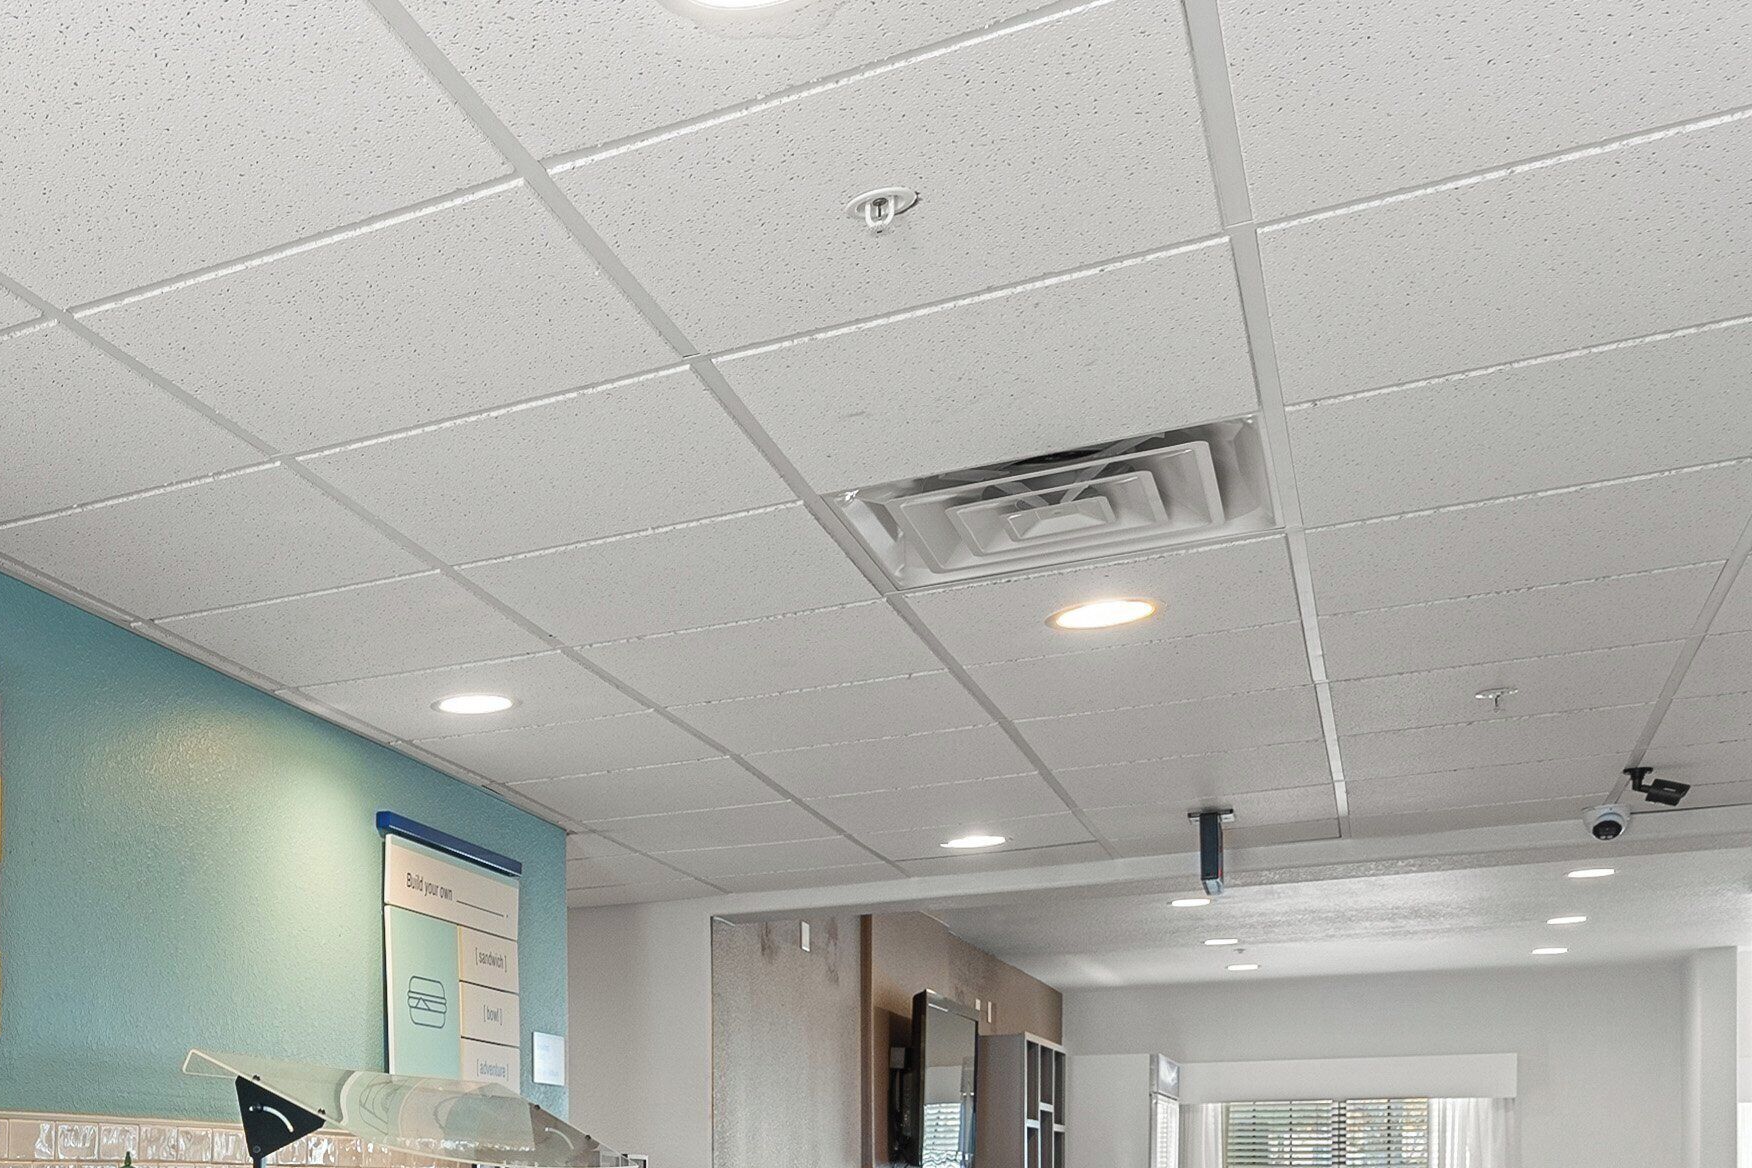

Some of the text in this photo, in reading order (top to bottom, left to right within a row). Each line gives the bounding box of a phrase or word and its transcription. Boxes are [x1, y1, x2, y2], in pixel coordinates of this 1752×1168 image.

[406, 872, 453, 901] Build your own
